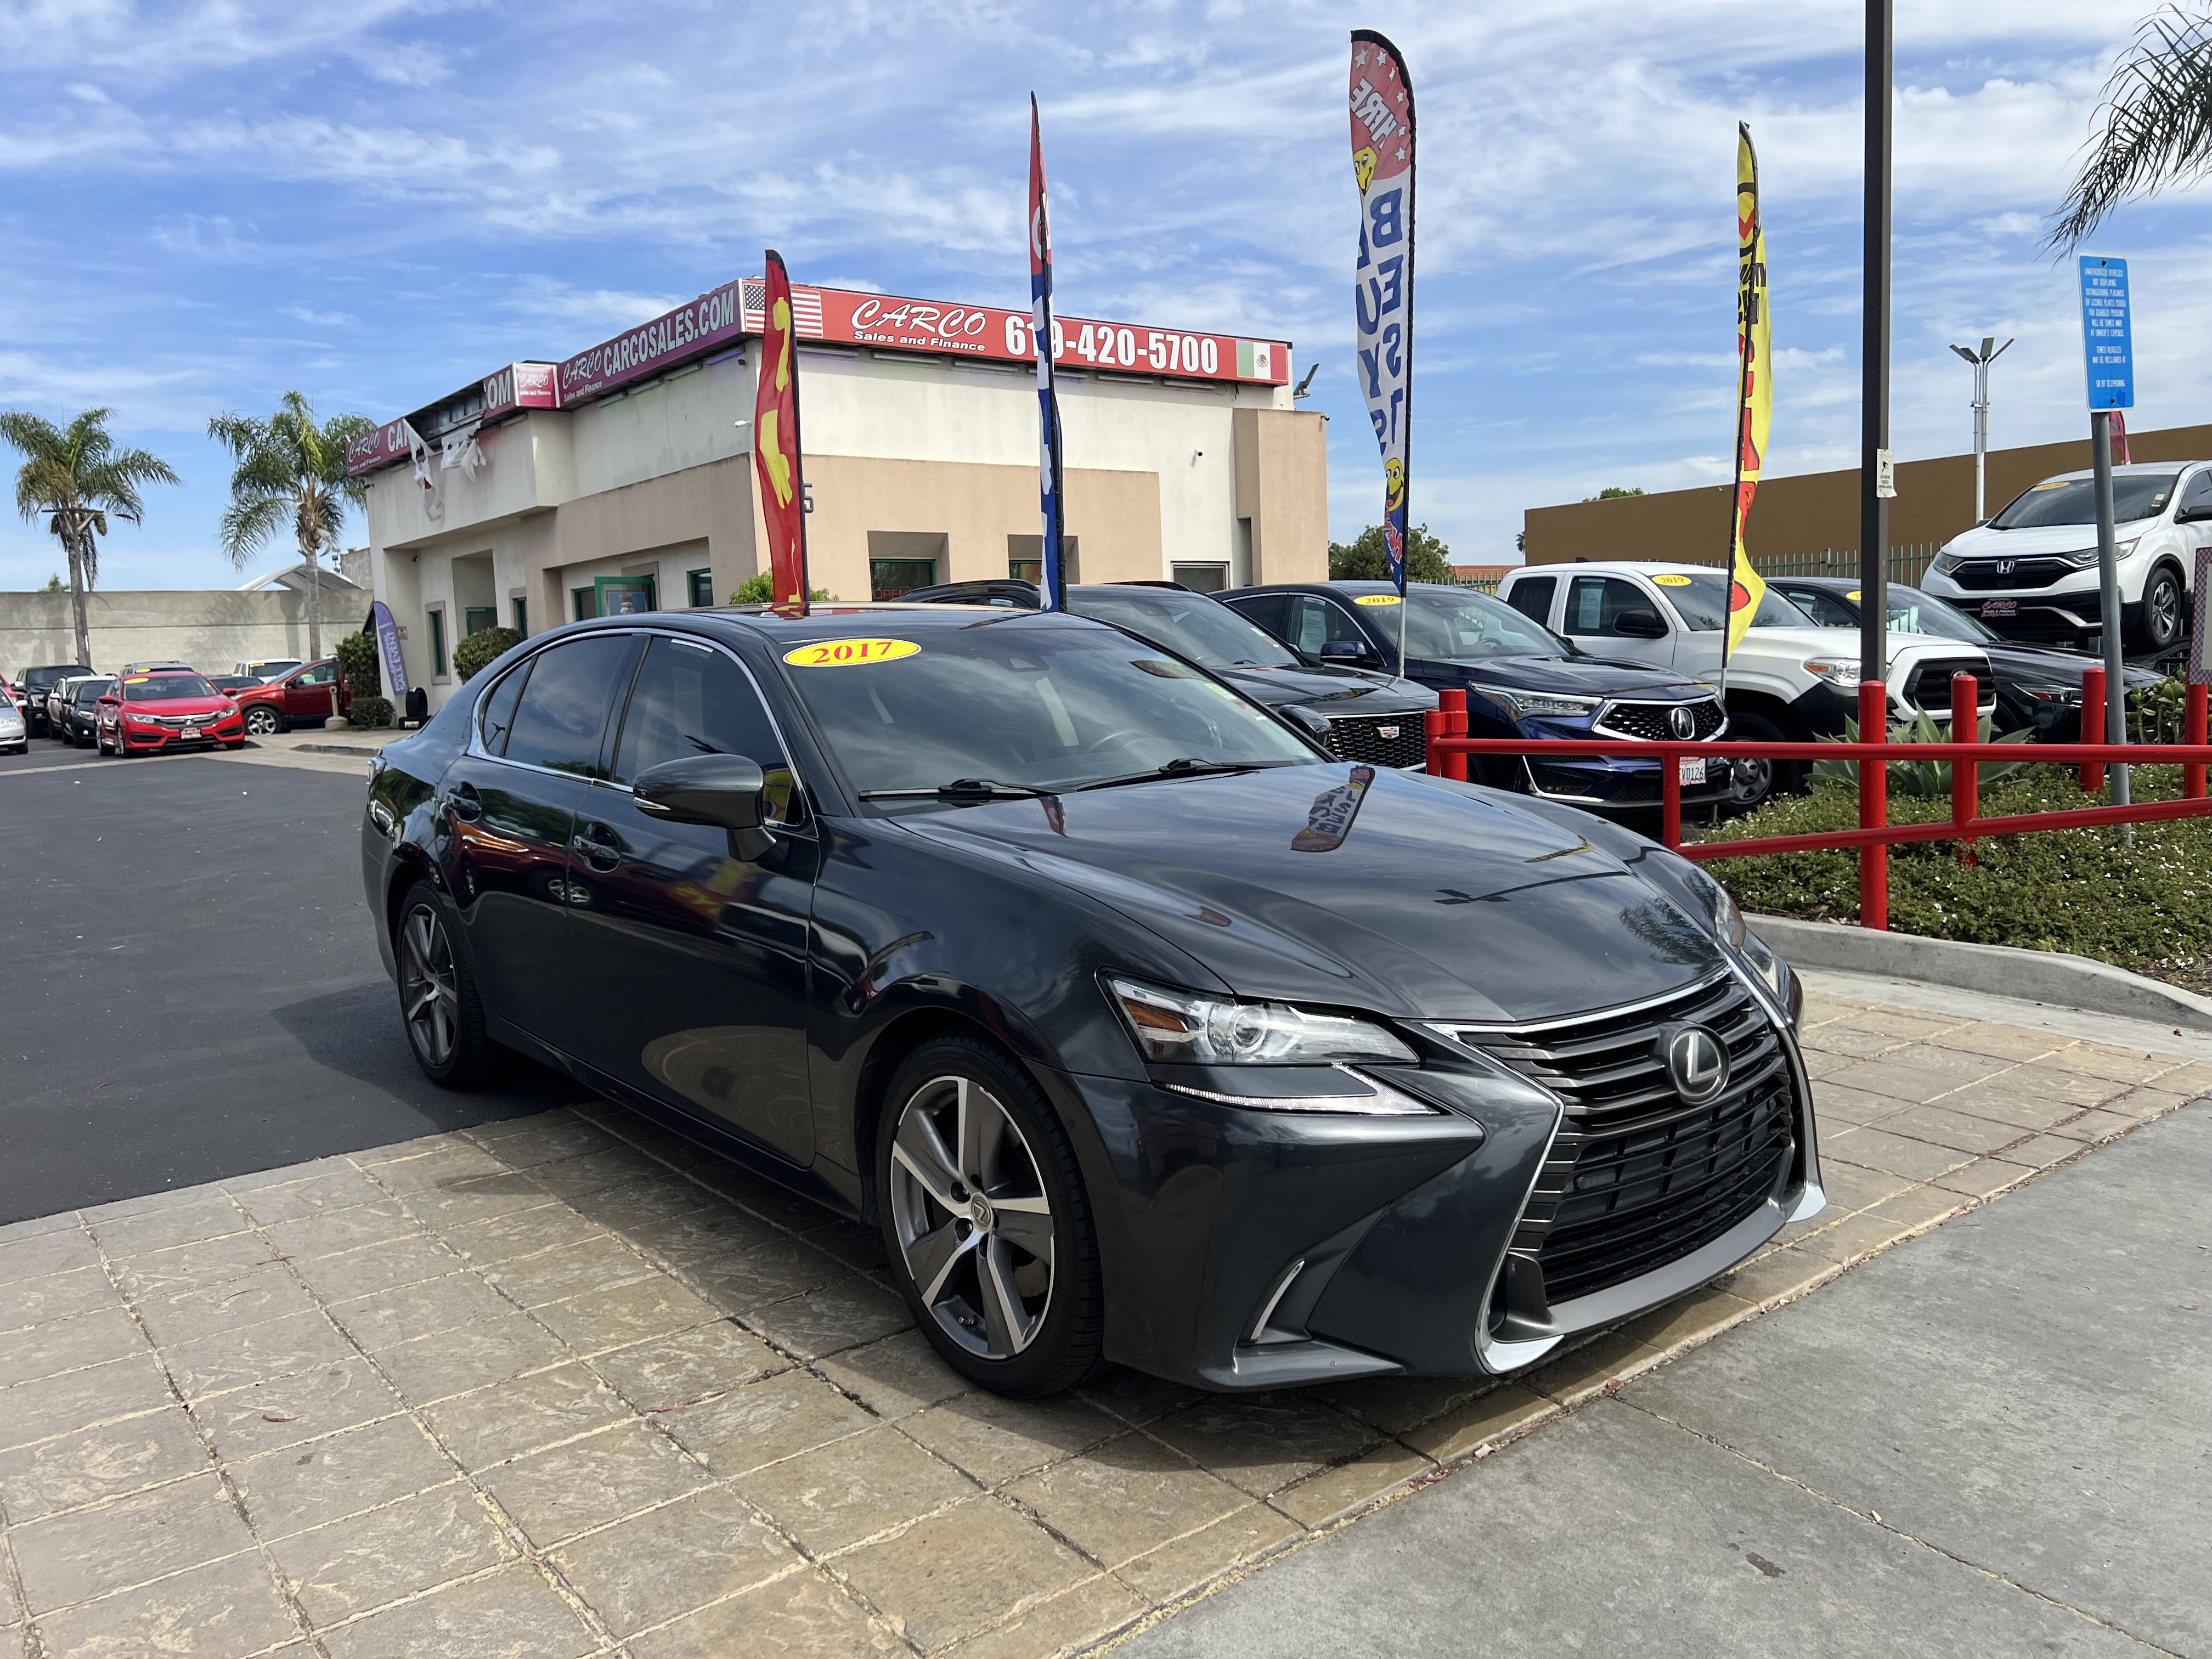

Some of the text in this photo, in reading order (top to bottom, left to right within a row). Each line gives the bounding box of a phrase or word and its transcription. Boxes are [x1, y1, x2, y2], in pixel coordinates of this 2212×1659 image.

[851, 299, 986, 338] CARCO
[603, 288, 734, 377] CARCOSALES.COM
[854, 330, 986, 352] Sales and Finance
[518, 373, 549, 388] CARCO
[562, 349, 602, 390] CARCO
[483, 370, 511, 410] OM
[564, 392, 575, 403] Sales
[584, 380, 602, 394] Finance
[349, 431, 380, 463] CARCO
[812, 641, 893, 664] 2017
[1679, 766, 1704, 780] VD126
